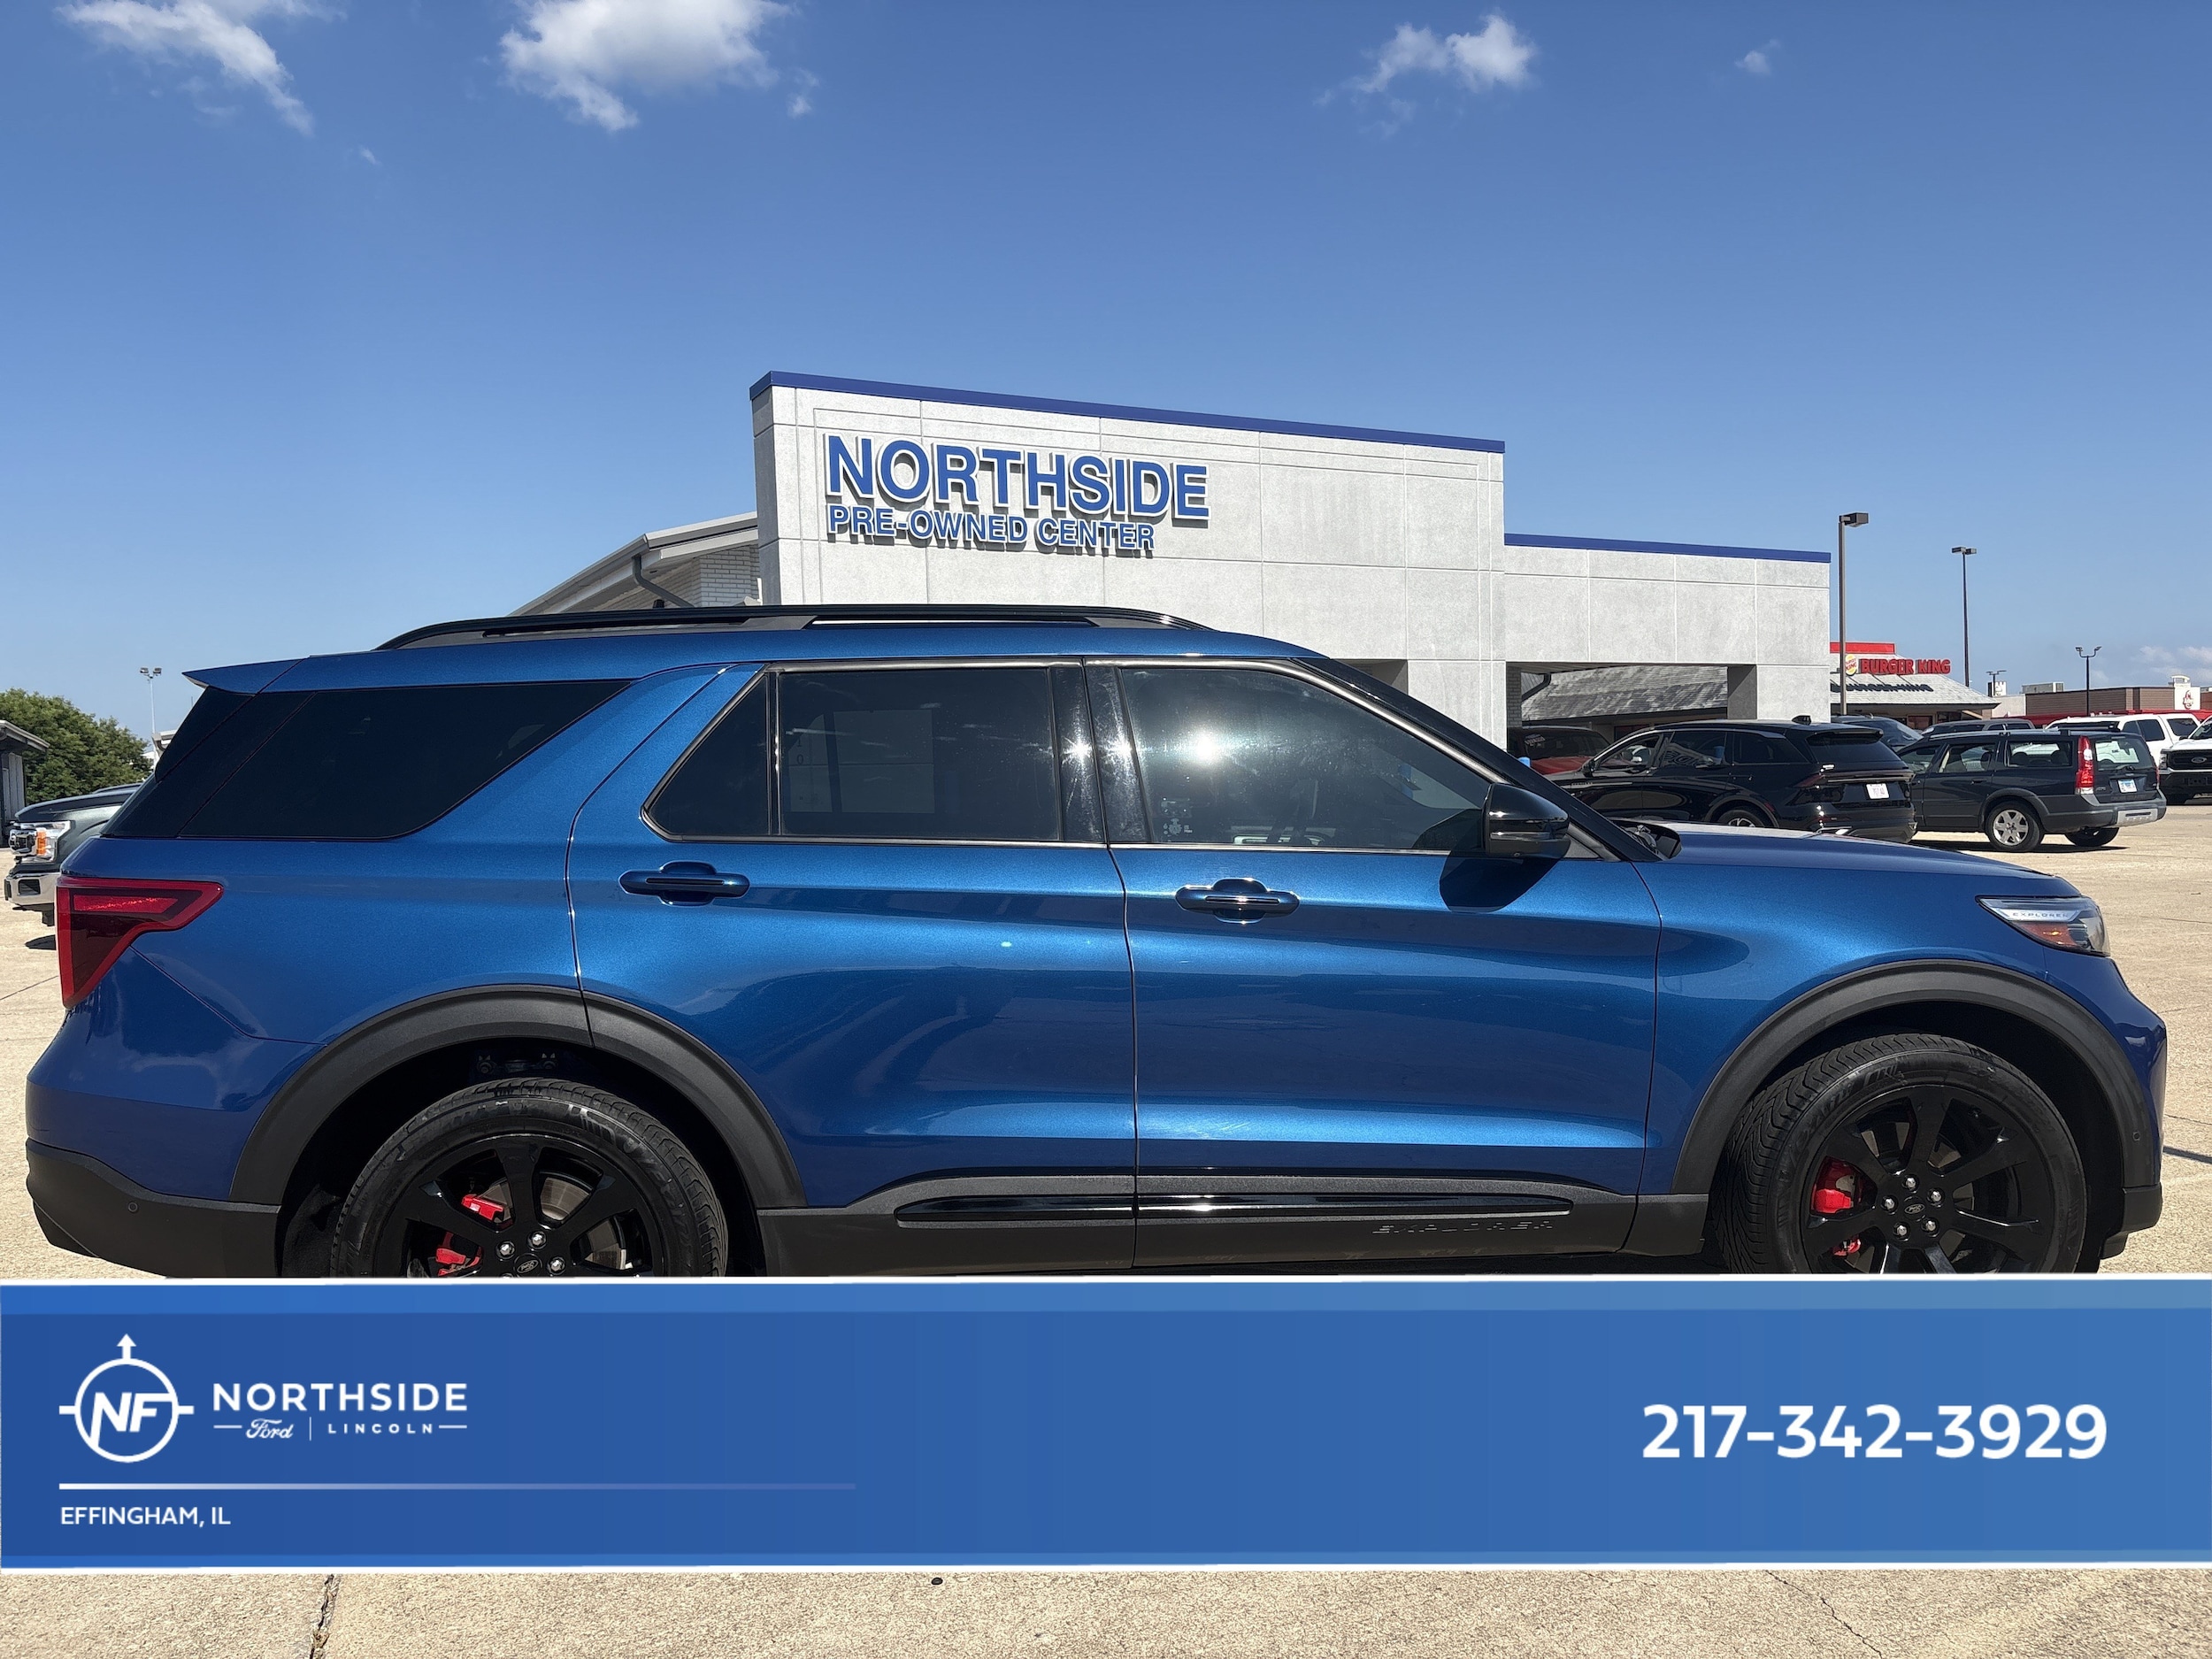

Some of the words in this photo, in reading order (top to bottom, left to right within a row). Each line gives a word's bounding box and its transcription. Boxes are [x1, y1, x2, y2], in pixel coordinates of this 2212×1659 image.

[824, 433, 1210, 520] NORTHSIDE
[828, 504, 1028, 543] PRE-OWNED
[1037, 518, 1156, 550] CENTER
[1860, 658, 1914, 675] BURGER
[1918, 658, 1951, 675] KING
